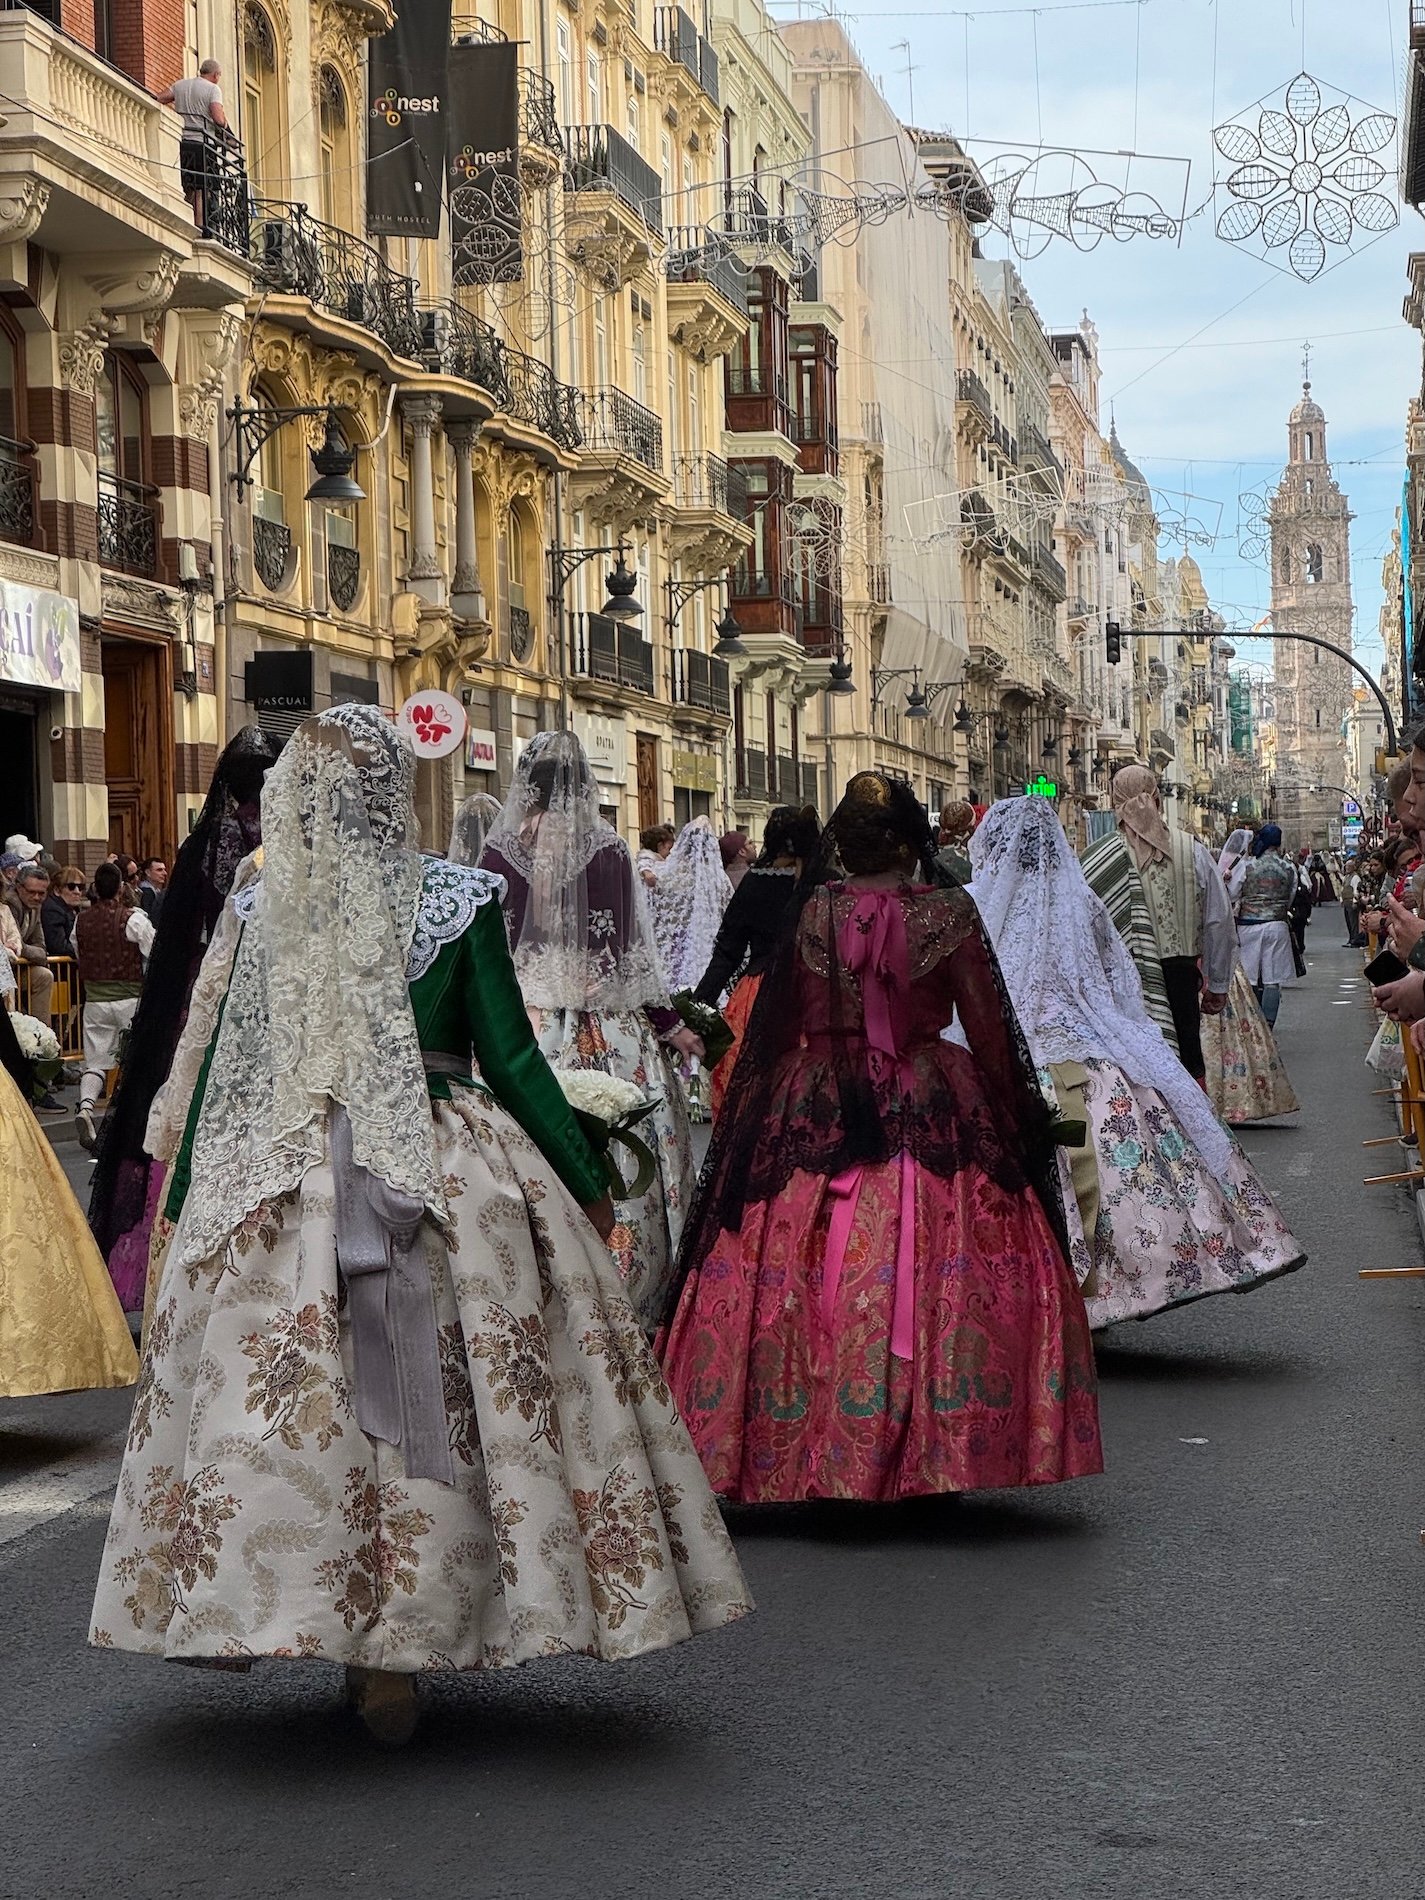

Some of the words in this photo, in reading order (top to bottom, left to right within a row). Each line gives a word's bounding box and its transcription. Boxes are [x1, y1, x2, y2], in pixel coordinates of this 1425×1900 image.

[397, 96, 440, 112] nest
[474, 147, 512, 165] nest
[397, 215, 430, 225] HOSTEL
[257, 696, 308, 706] PASCUAL
